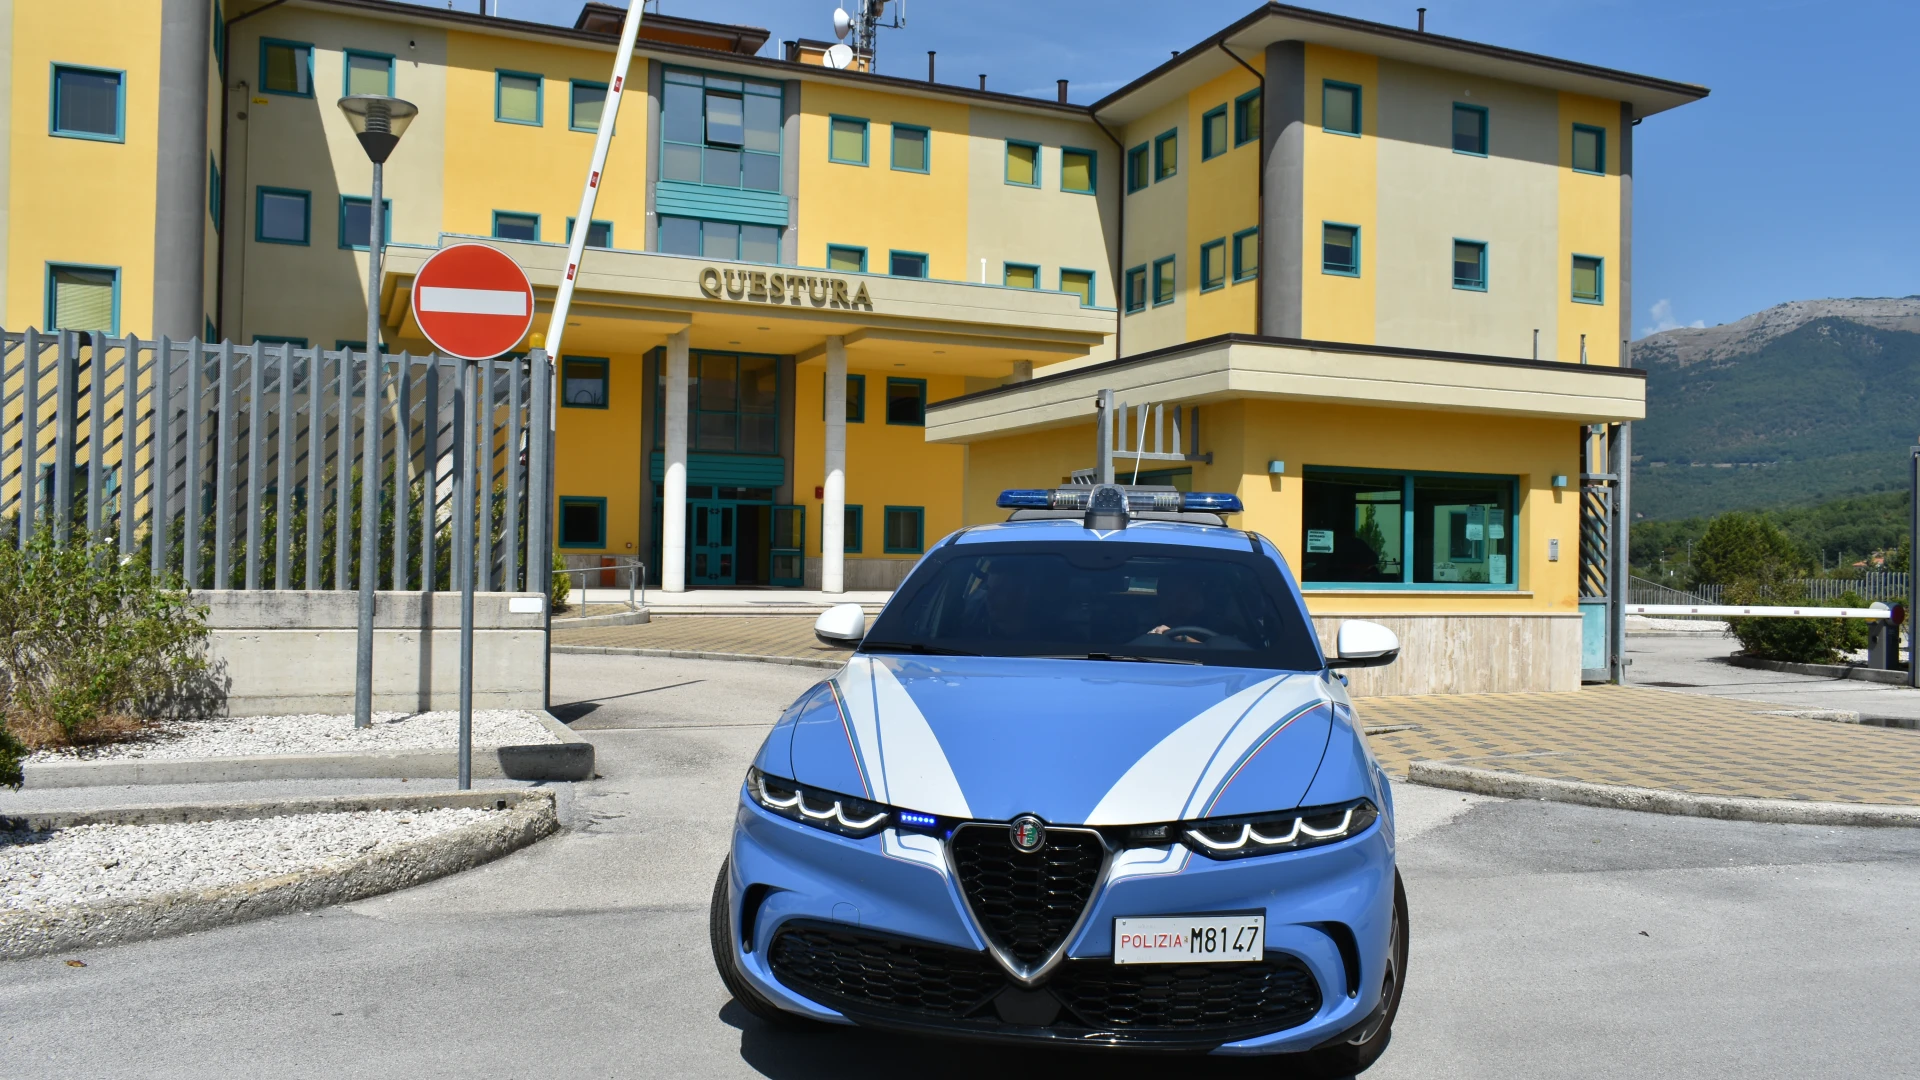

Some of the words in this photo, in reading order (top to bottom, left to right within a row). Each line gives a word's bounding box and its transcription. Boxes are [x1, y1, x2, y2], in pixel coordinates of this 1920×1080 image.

[699, 267, 873, 305] QUESTURA
[1121, 934, 1182, 949] POLIZIA
[1190, 926, 1259, 953] M8147
